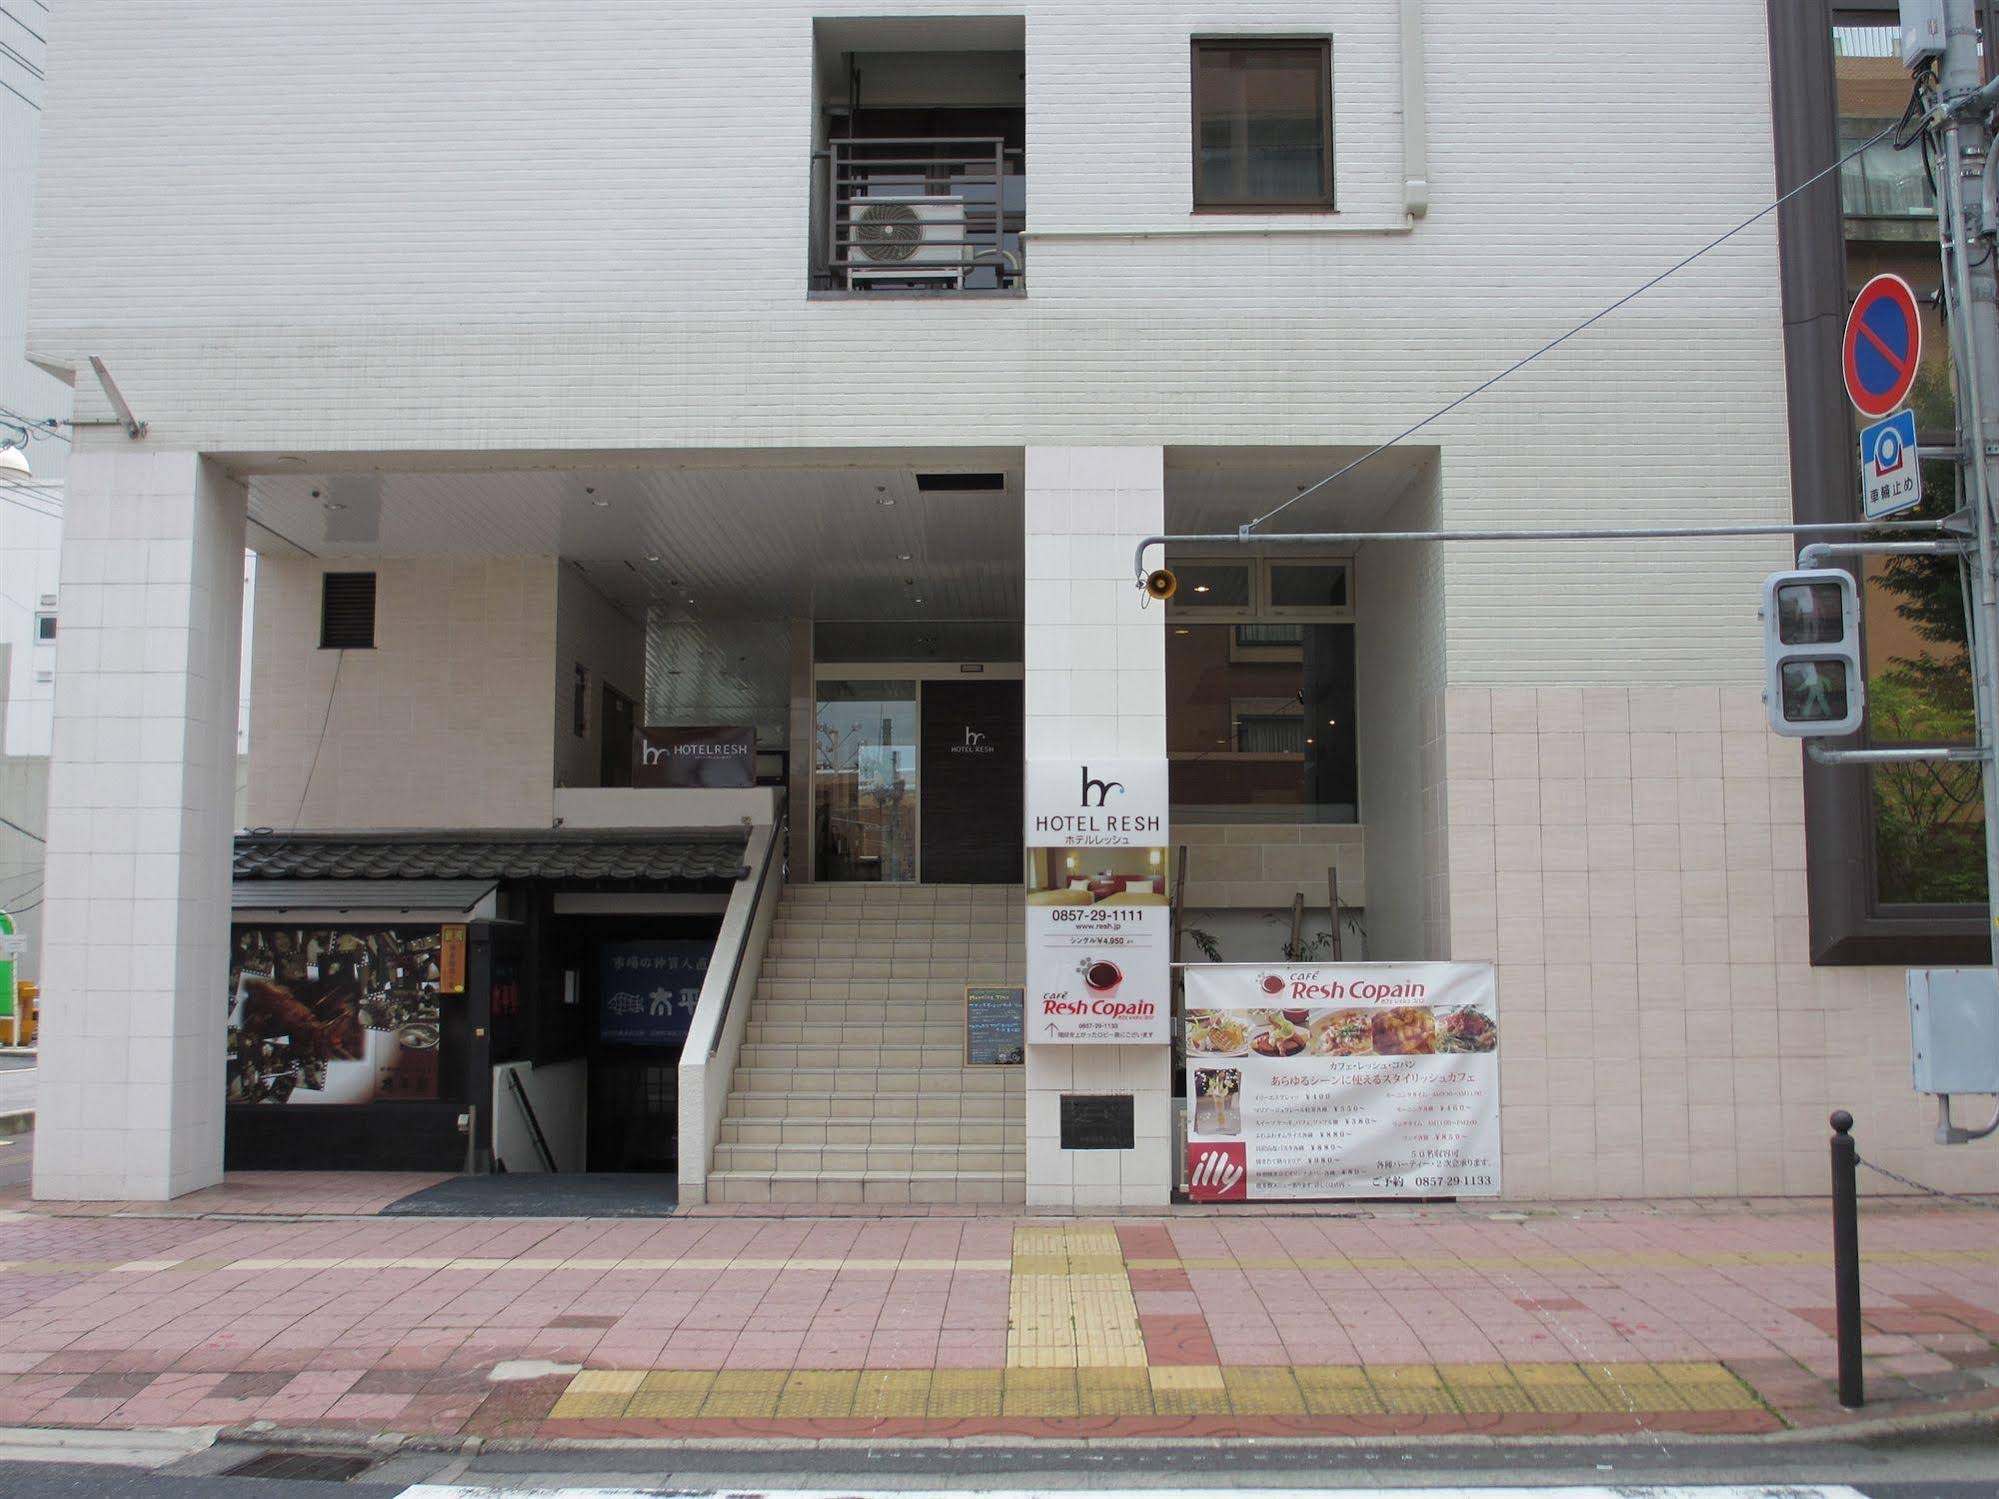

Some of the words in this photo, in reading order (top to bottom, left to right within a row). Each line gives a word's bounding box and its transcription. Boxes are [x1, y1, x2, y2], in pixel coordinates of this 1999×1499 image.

[1870, 477, 1914, 503] 車輪止め
[1036, 815, 1100, 831] HOTEL
[1107, 815, 1159, 831] RESH
[1065, 835, 1130, 845] ホテルレッシュ
[1052, 909, 1143, 921] 0857-29-1111
[1075, 923, 1121, 931] www.resh.jp
[1290, 981, 1344, 999] Resh
[1349, 979, 1425, 1003] Copain
[1043, 1000, 1088, 1015] Resh
[1092, 1000, 1154, 1019] Copain
[1271, 1072, 1475, 1086] あらゆるシーンに使えるスタイリッシュカフェ
[1192, 1151, 1243, 1194] illy
